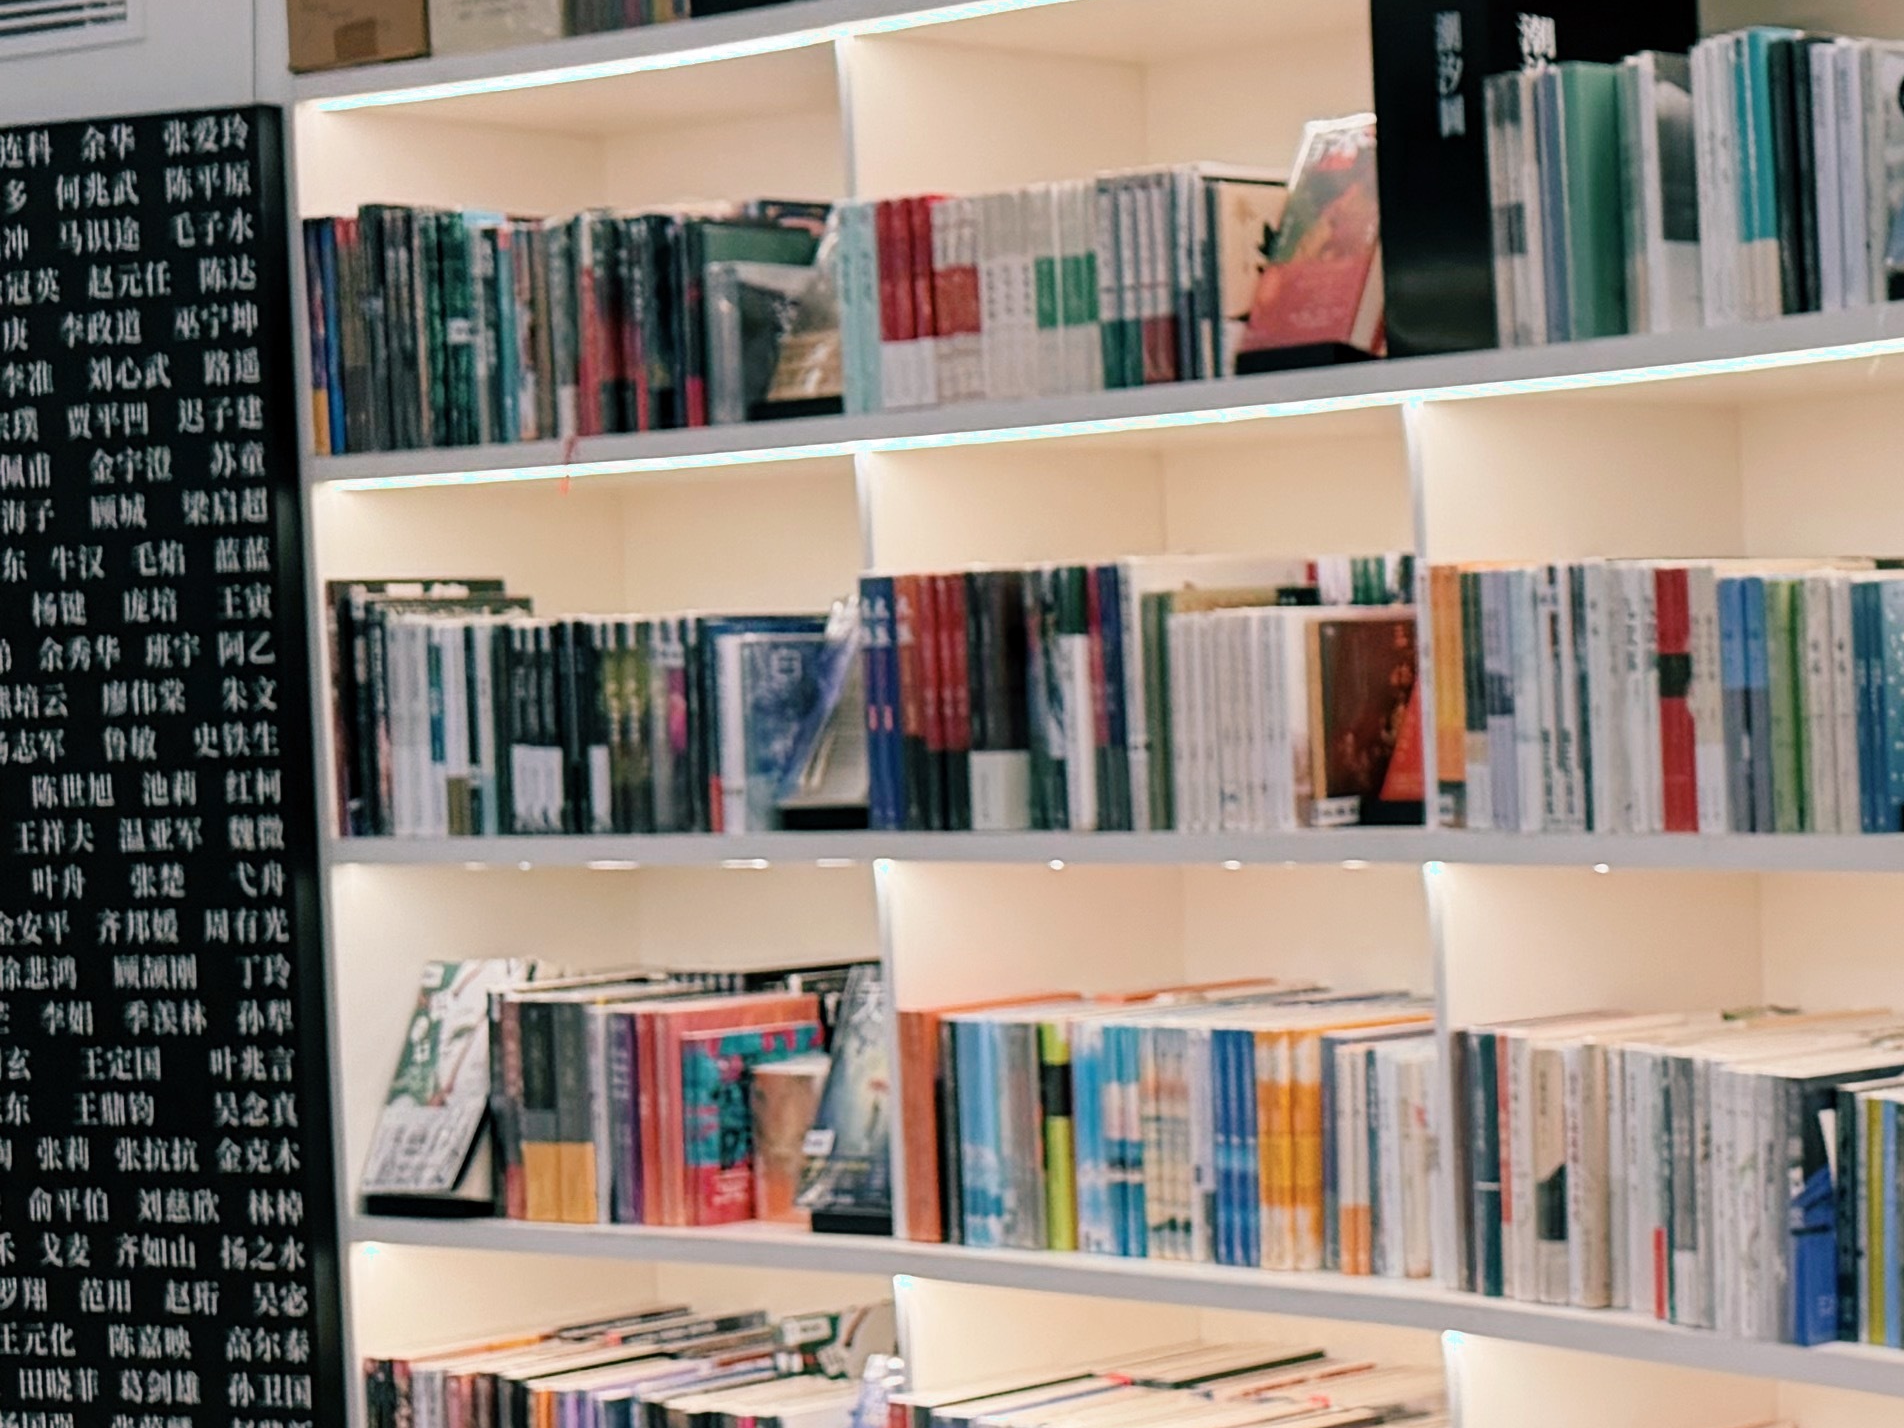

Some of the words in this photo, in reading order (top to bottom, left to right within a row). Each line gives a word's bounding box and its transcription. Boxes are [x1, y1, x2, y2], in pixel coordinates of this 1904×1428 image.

[81, 124, 137, 163] 余华
[163, 113, 250, 157] 张爱玲
[56, 170, 140, 211] 何兆武
[165, 160, 251, 205] 陈平原
[58, 216, 141, 256] 马识途
[170, 206, 255, 248] 毛子水
[88, 260, 171, 300] 赵元任
[200, 253, 257, 294] 陈达
[61, 308, 142, 348] 李政道
[88, 351, 172, 392] 刘心武
[204, 346, 260, 386] 路遥
[66, 402, 150, 440] 贾平凹
[178, 393, 264, 433] 迟子建
[90, 447, 172, 484] 金宇澄
[210, 439, 266, 479] 苏童
[2, 498, 55, 535] 海子
[90, 492, 147, 529] 顾城
[181, 486, 268, 526] 梁启超
[51, 543, 105, 582] 牛汉
[214, 534, 271, 573] 蓝蓝
[39, 634, 121, 672] 余秀华
[217, 629, 276, 668] 阿乙
[102, 678, 186, 716] 廖伟棠
[221, 675, 278, 714] 朱文
[193, 720, 280, 759] 史铁生
[142, 770, 197, 808] 池莉
[225, 767, 282, 806] 红柯
[15, 818, 95, 855] 王祥夫
[228, 814, 285, 852] 魏微
[31, 864, 86, 901] 叶舟
[130, 862, 186, 899] 张楚
[98, 907, 179, 946] 齐邦媛
[205, 906, 289, 943] 周有光
[114, 953, 198, 991] 顾颉刚
[236, 952, 291, 990] 丁玲
[42, 1000, 93, 1036] 李娟
[125, 1000, 207, 1036] 季羡林
[238, 999, 295, 1036] 孙犁
[82, 1046, 161, 1082] 王定国
[210, 1046, 295, 1082] 叶兆言
[75, 1091, 155, 1126] 王鼎钧
[213, 1091, 299, 1129] 吴念真
[115, 1137, 200, 1172] 张抗抗
[217, 1136, 301, 1174] 金克木
[30, 1187, 109, 1223] 俞平伯
[139, 1188, 220, 1223] 刘慈欣
[117, 1233, 197, 1268] 齐如山
[220, 1235, 306, 1271] 扬之水
[107, 1324, 191, 1359] 陈嘉映
[226, 1325, 311, 1363] 高尔泰
[19, 1368, 99, 1402] 田晓菲
[120, 1369, 201, 1404] 葛剑雄
